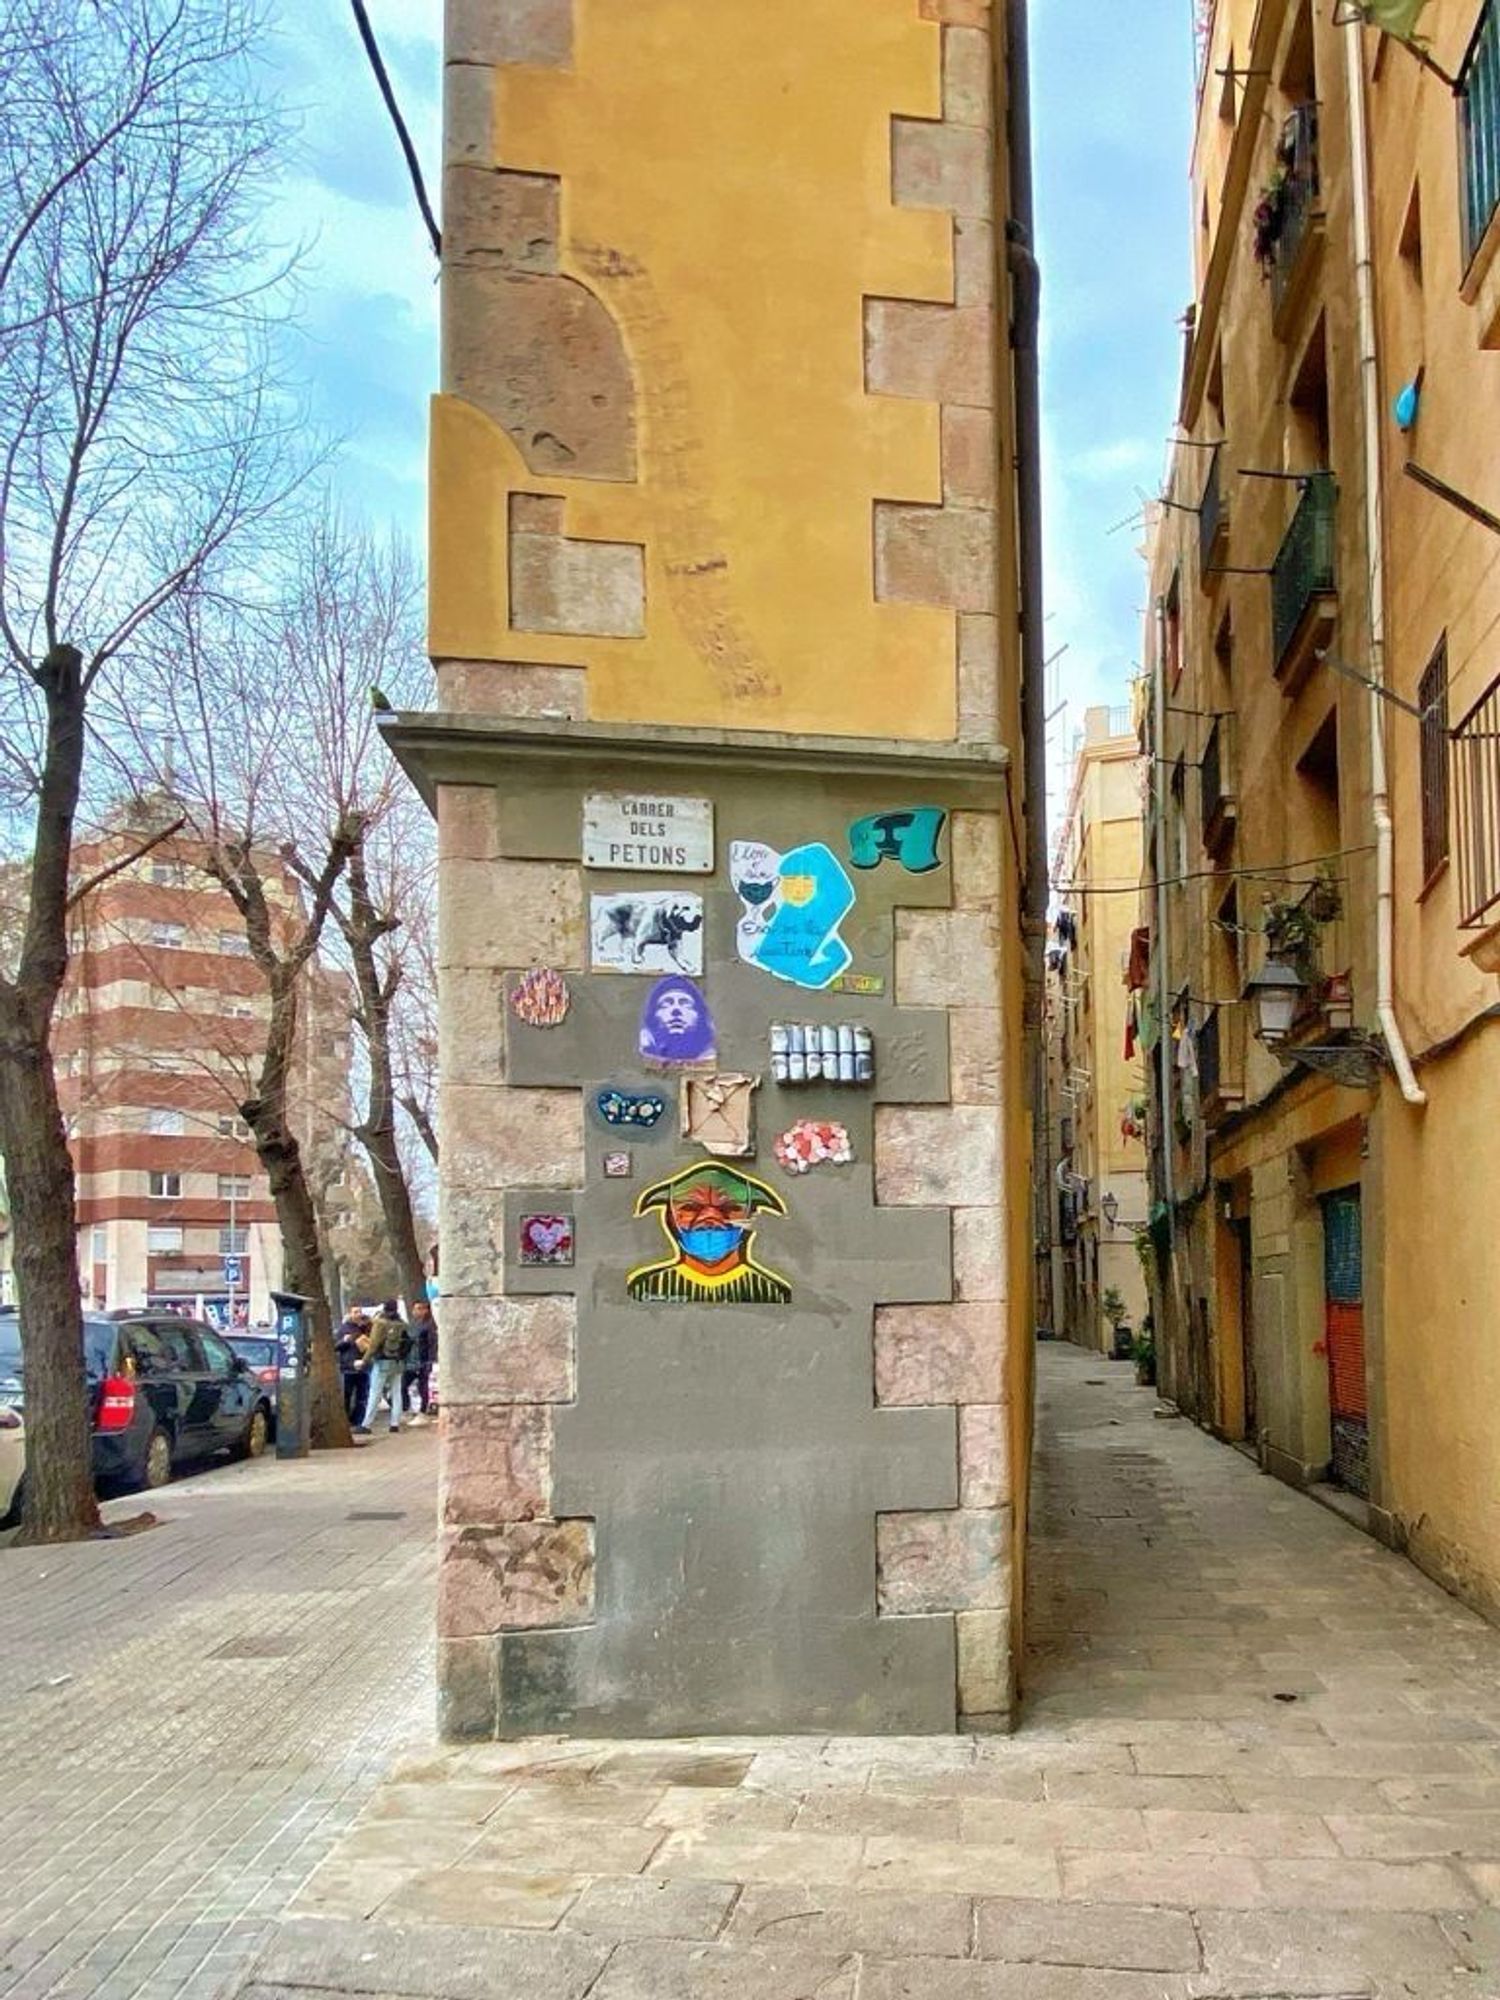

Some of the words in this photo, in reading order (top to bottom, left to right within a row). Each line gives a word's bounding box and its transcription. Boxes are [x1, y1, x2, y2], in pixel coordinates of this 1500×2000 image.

[621, 802, 674, 818] CARRER
[630, 822, 666, 837] DELS
[609, 843, 687, 866] PETONS
[228, 1268, 238, 1281] P
